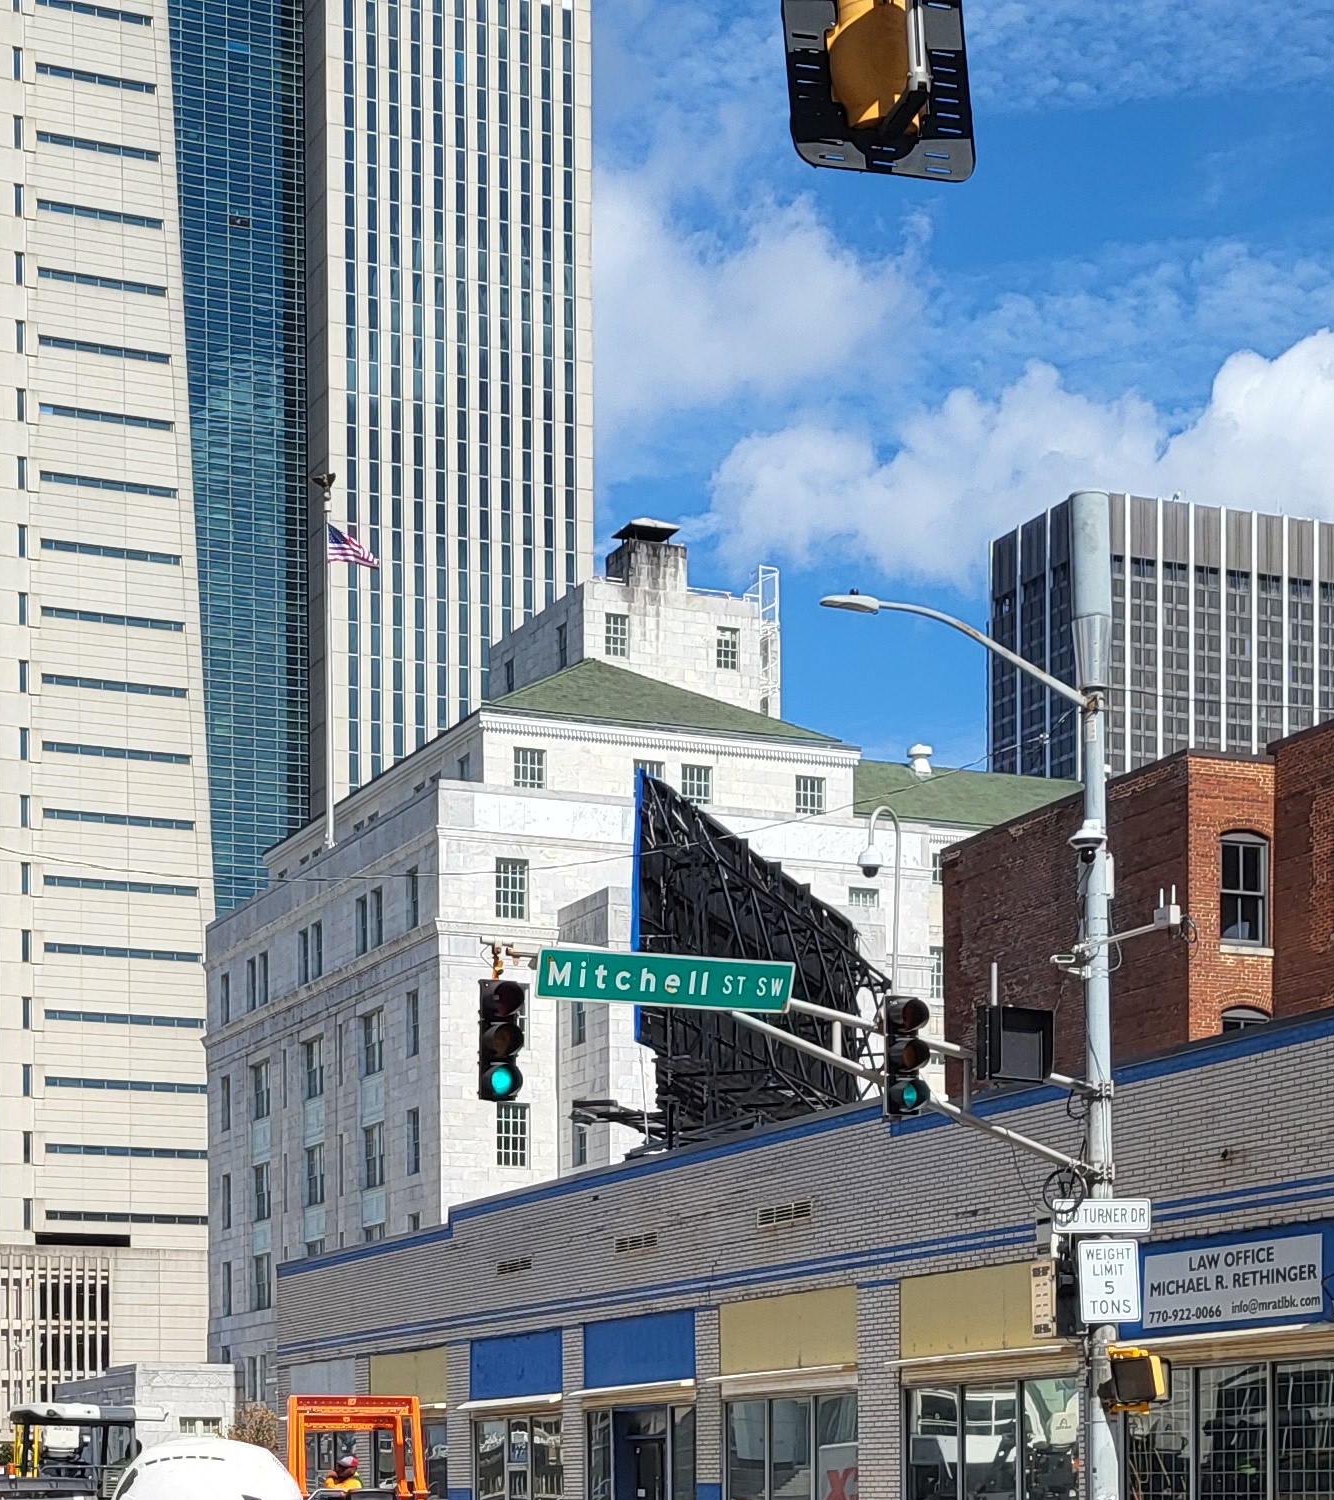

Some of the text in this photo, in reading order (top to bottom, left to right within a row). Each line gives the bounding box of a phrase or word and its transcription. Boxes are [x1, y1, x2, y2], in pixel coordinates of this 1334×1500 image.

[547, 961, 784, 997] Mitchell ST SW
[1083, 1208, 1127, 1223] TURNER
[1131, 1208, 1146, 1222] DR
[1086, 1248, 1131, 1260] WEIGHT
[1189, 1246, 1275, 1271] LAW OFFICE
[1093, 1264, 1124, 1276] LIMIT
[1105, 1281, 1114, 1294] 5
[1150, 1264, 1317, 1297] MICHAEL R. RETHINGER
[1090, 1300, 1131, 1314] TONS
[1149, 1305, 1222, 1323] 770-922-0066
